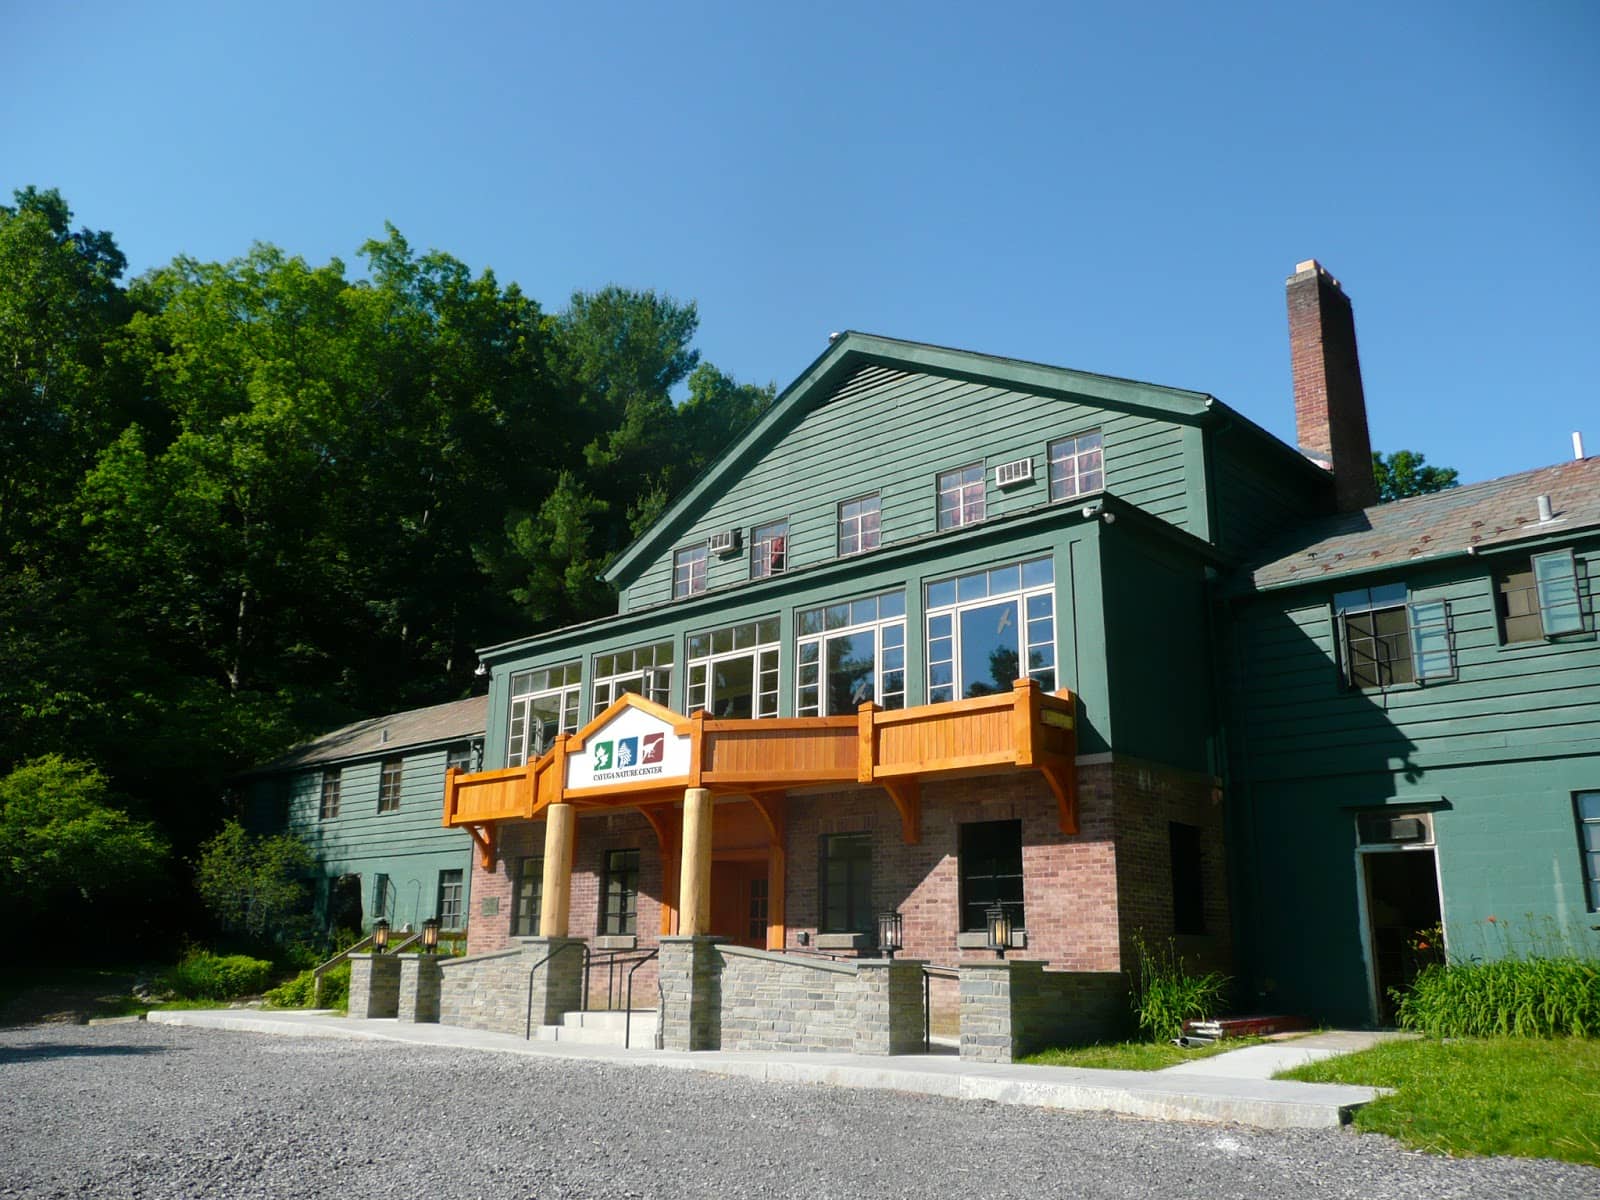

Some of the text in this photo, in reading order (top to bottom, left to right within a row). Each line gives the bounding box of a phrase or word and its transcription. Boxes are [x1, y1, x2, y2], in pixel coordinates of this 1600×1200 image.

[593, 766, 662, 781] CAYUGA NATURE CENTER
